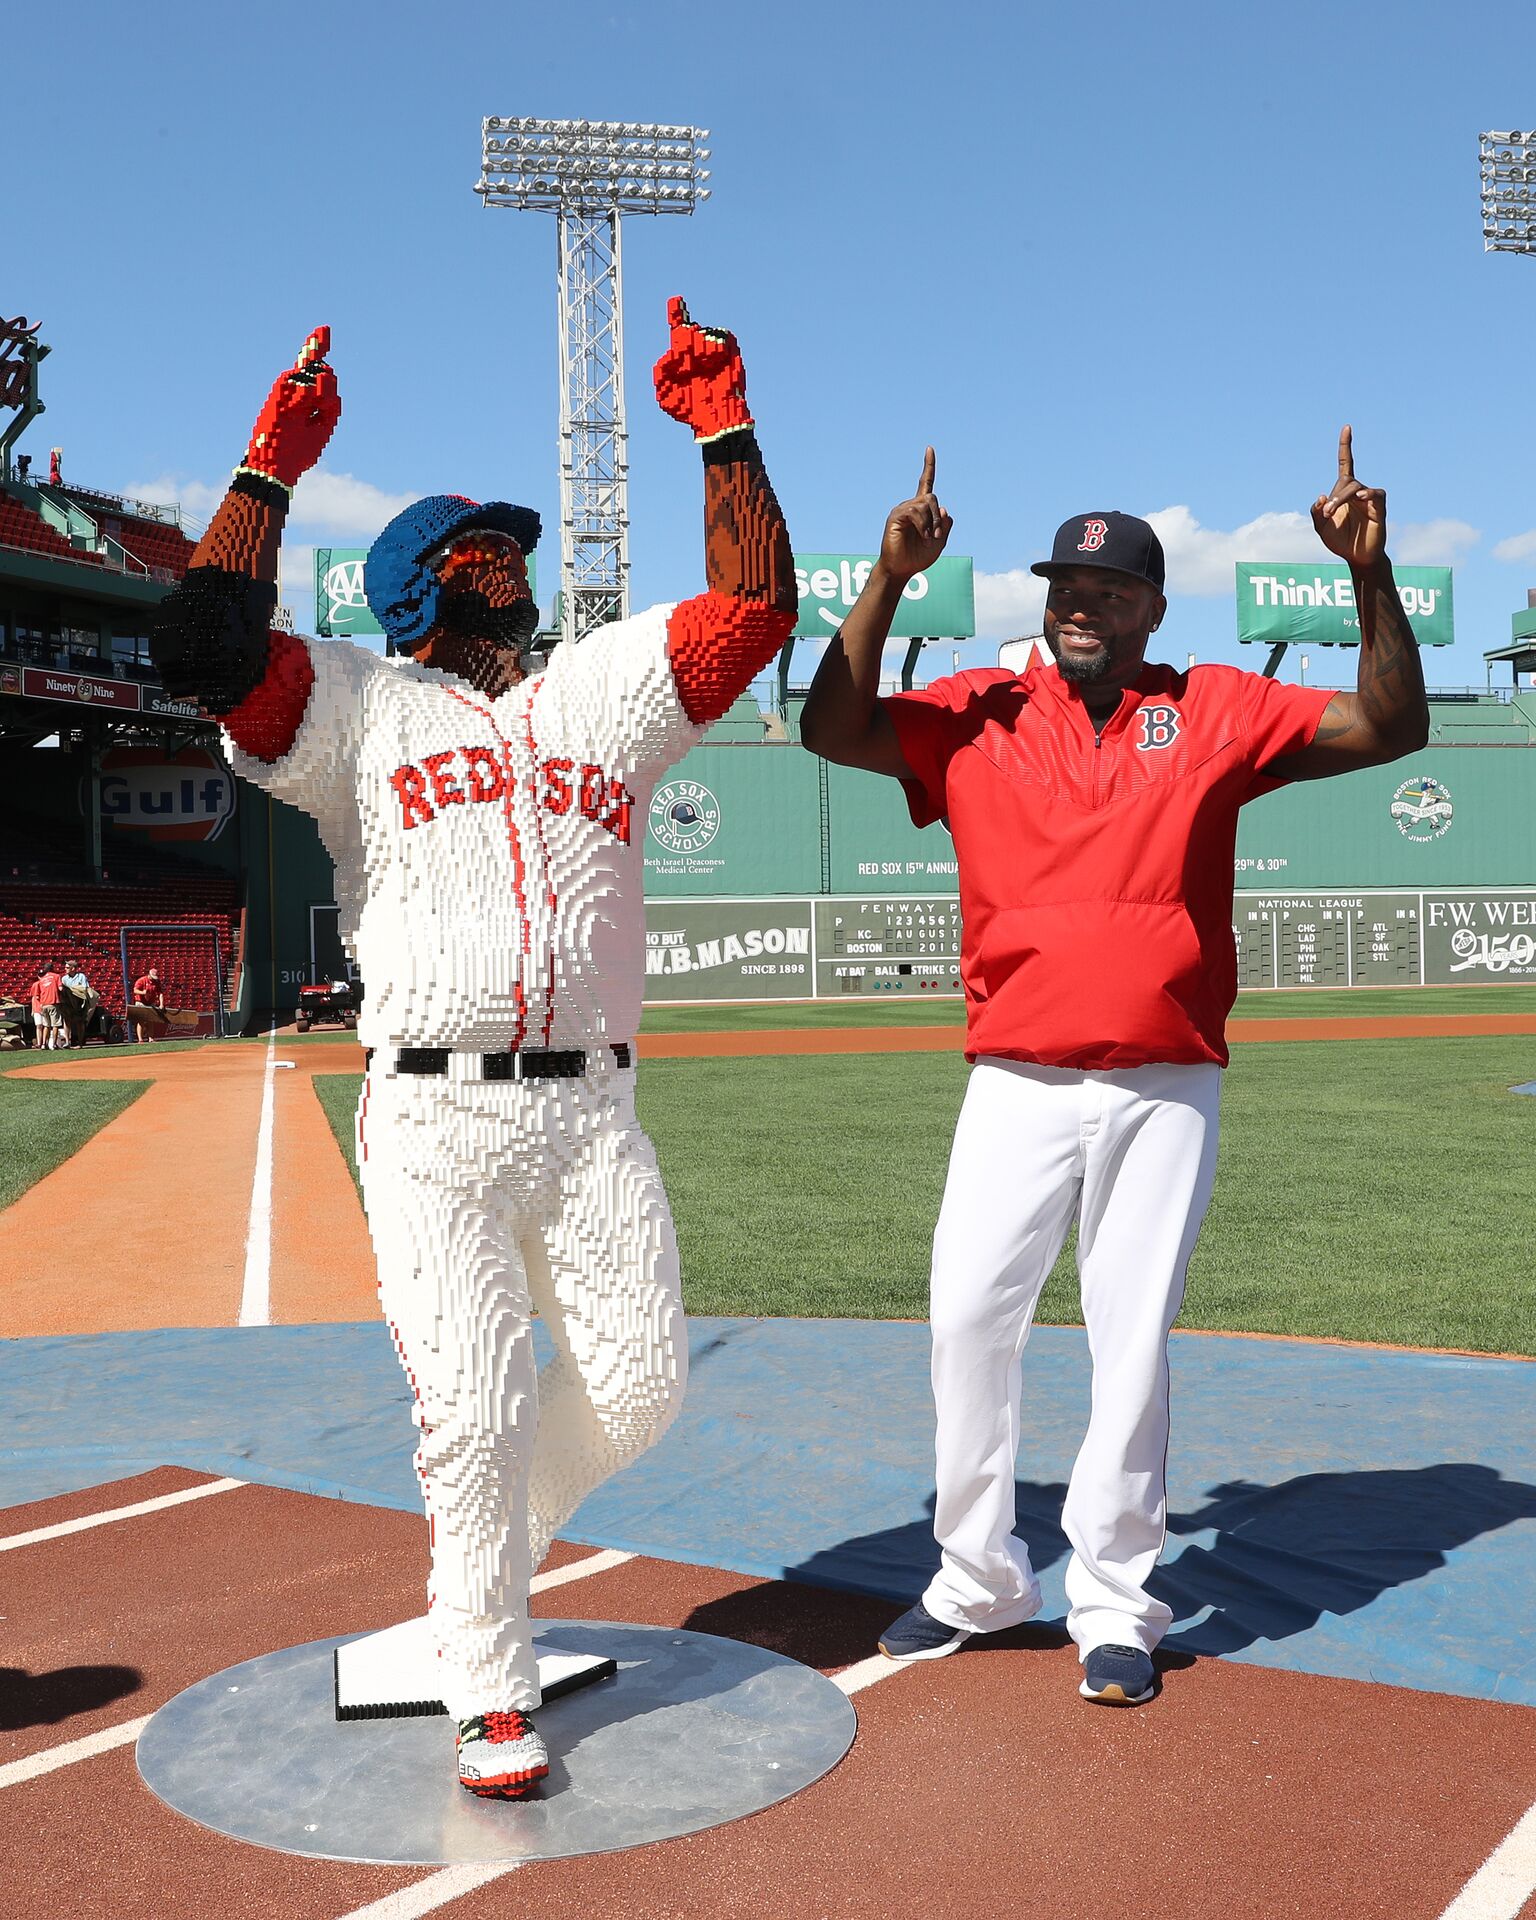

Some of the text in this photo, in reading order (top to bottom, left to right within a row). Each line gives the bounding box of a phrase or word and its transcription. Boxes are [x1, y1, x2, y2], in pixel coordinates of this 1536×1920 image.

[1077, 519, 1110, 552] B
[1250, 576, 1436, 616] ThinkEgy
[1343, 618, 1353, 628] by
[46, 678, 77, 694] Ninety
[93, 687, 115, 699] Nine
[152, 699, 198, 717] Safelite
[1136, 705, 1182, 752] B
[390, 746, 504, 829] RED
[1393, 776, 1451, 800] BOSTON RED SOX
[101, 775, 224, 814] Gulf
[652, 783, 707, 815] RED SOX
[655, 810, 717, 850] SCHOLARS
[1396, 819, 1452, 842] THE JIMMY FUND
[643, 858, 726, 866] Beth Israel Deaconess
[1256, 858, 1265, 871] &
[1267, 858, 1288, 871] 30TH
[656, 866, 714, 874] Medical Center
[858, 862, 879, 875] RED
[881, 862, 902, 875] SOX
[926, 862, 959, 874] ANNUA
[1258, 899, 1363, 908] NATIONAL LEAGUE
[1248, 909, 1416, 921] IN R P IN R P IN R
[1427, 902, 1476, 927] F.W.
[835, 917, 843, 927] P
[887, 916, 891, 926] 1
[895, 915, 903, 926] 2
[905, 915, 913, 926] 3
[918, 915, 926, 926] 4
[928, 915, 936, 926] 5
[937, 915, 945, 926] 6
[951, 915, 958, 926] 7
[1297, 923, 1316, 933] CHC
[1372, 923, 1388, 932] ATL
[646, 932, 685, 946] HO BUT
[857, 929, 872, 940] KC
[1298, 933, 1316, 943] LAD
[1374, 932, 1386, 941] SF
[846, 943, 883, 954] BOSTON
[1300, 944, 1314, 953] PHI
[1371, 943, 1389, 952] OAK
[1297, 954, 1317, 963] NYM
[1372, 953, 1389, 961] STL
[740, 963, 805, 975] SINCE 1898
[835, 967, 847, 977] AT
[848, 966, 866, 977] BAT
[874, 966, 900, 976] BALL
[910, 964, 945, 975] STRIKE
[1300, 964, 1315, 973] PIT
[1509, 966, 1522, 974] 1866
[280, 970, 306, 984] 310
[1300, 973, 1315, 983] MIL
